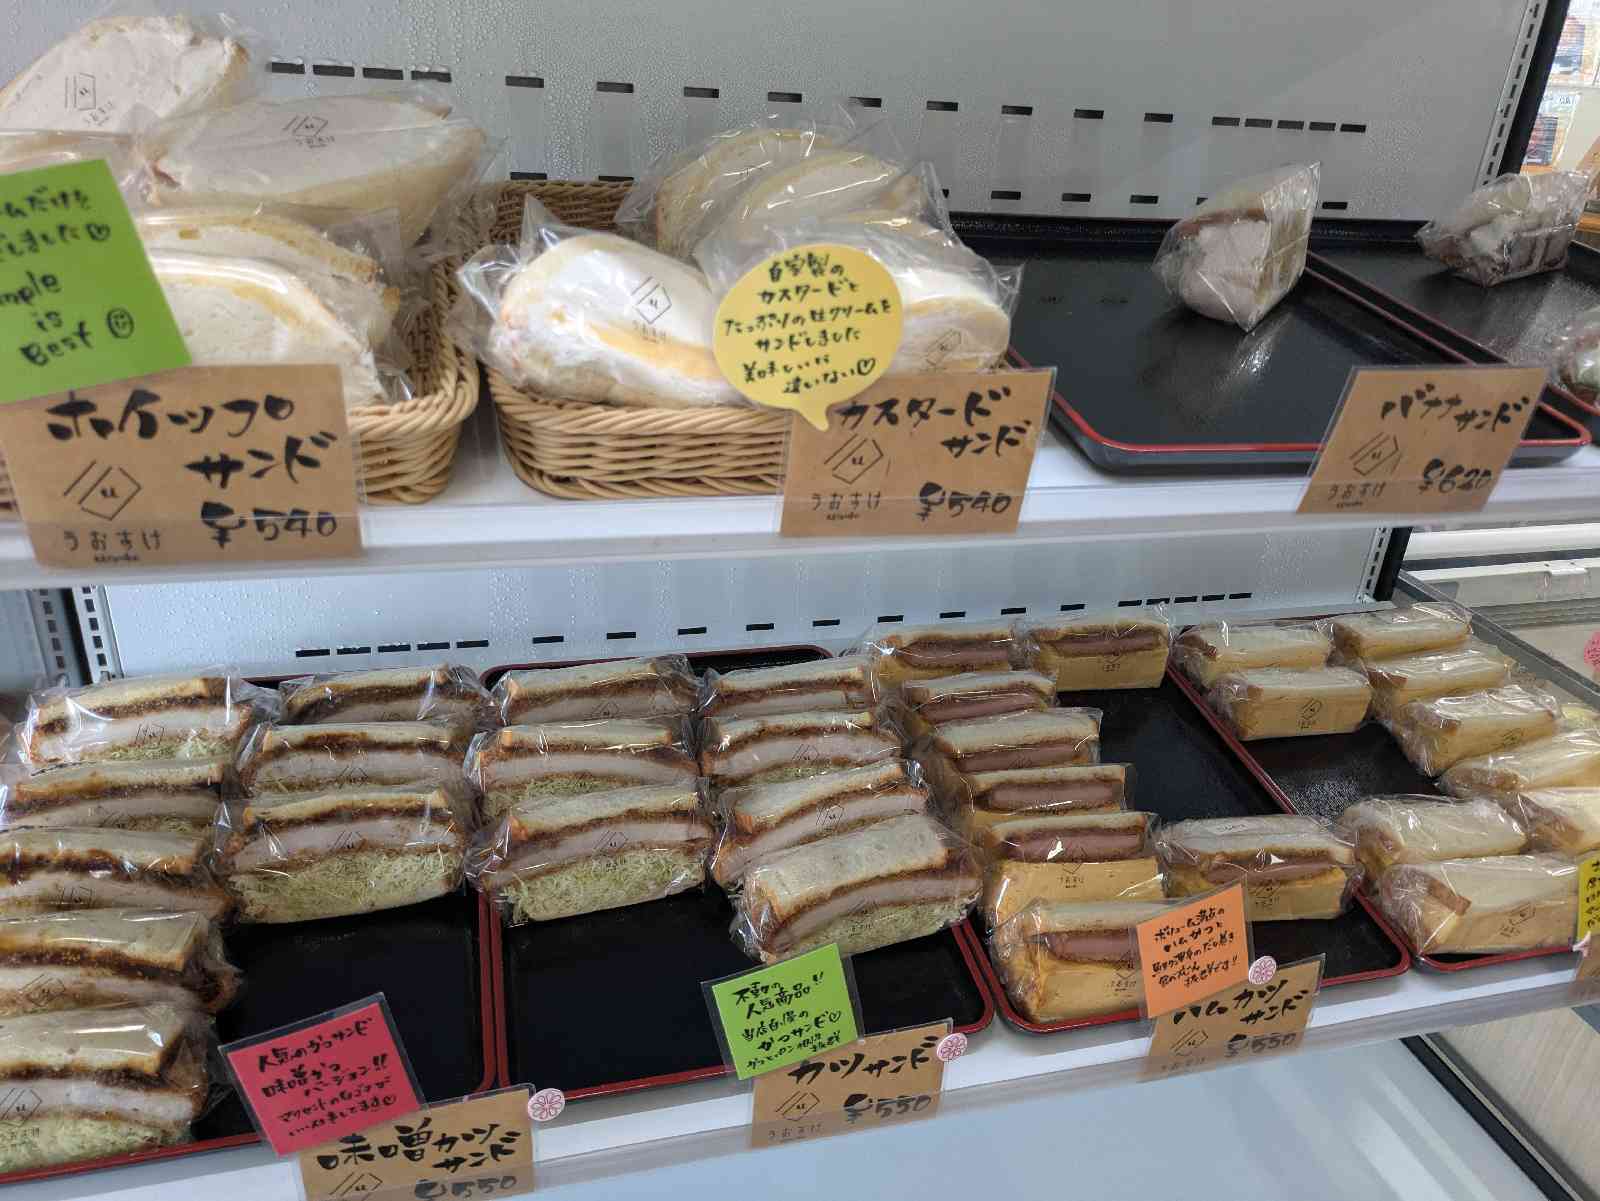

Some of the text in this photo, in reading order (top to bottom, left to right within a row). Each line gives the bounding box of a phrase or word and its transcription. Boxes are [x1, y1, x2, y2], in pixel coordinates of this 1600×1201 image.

[757, 277, 859, 304] カスタードと
[31, 310, 64, 333] is
[755, 327, 861, 352] サンドしました
[20, 320, 95, 367] Best
[46, 390, 294, 440] ホイップ
[836, 387, 1011, 430] カスタード
[1381, 383, 1462, 419] バナナ
[1454, 396, 1530, 432] サンド
[940, 419, 1031, 458] サンド
[185, 431, 338, 488] サンド
[811, 491, 881, 511] うおすけ
[917, 482, 1012, 520] ¥540
[63, 530, 162, 552] うおすけ
[200, 501, 338, 549] ¥540
[1240, 990, 1309, 1024] サンド
[844, 1093, 931, 1124] ¥550
[317, 1117, 500, 1170] 味噌カツ
[432, 1131, 521, 1173] サンド
